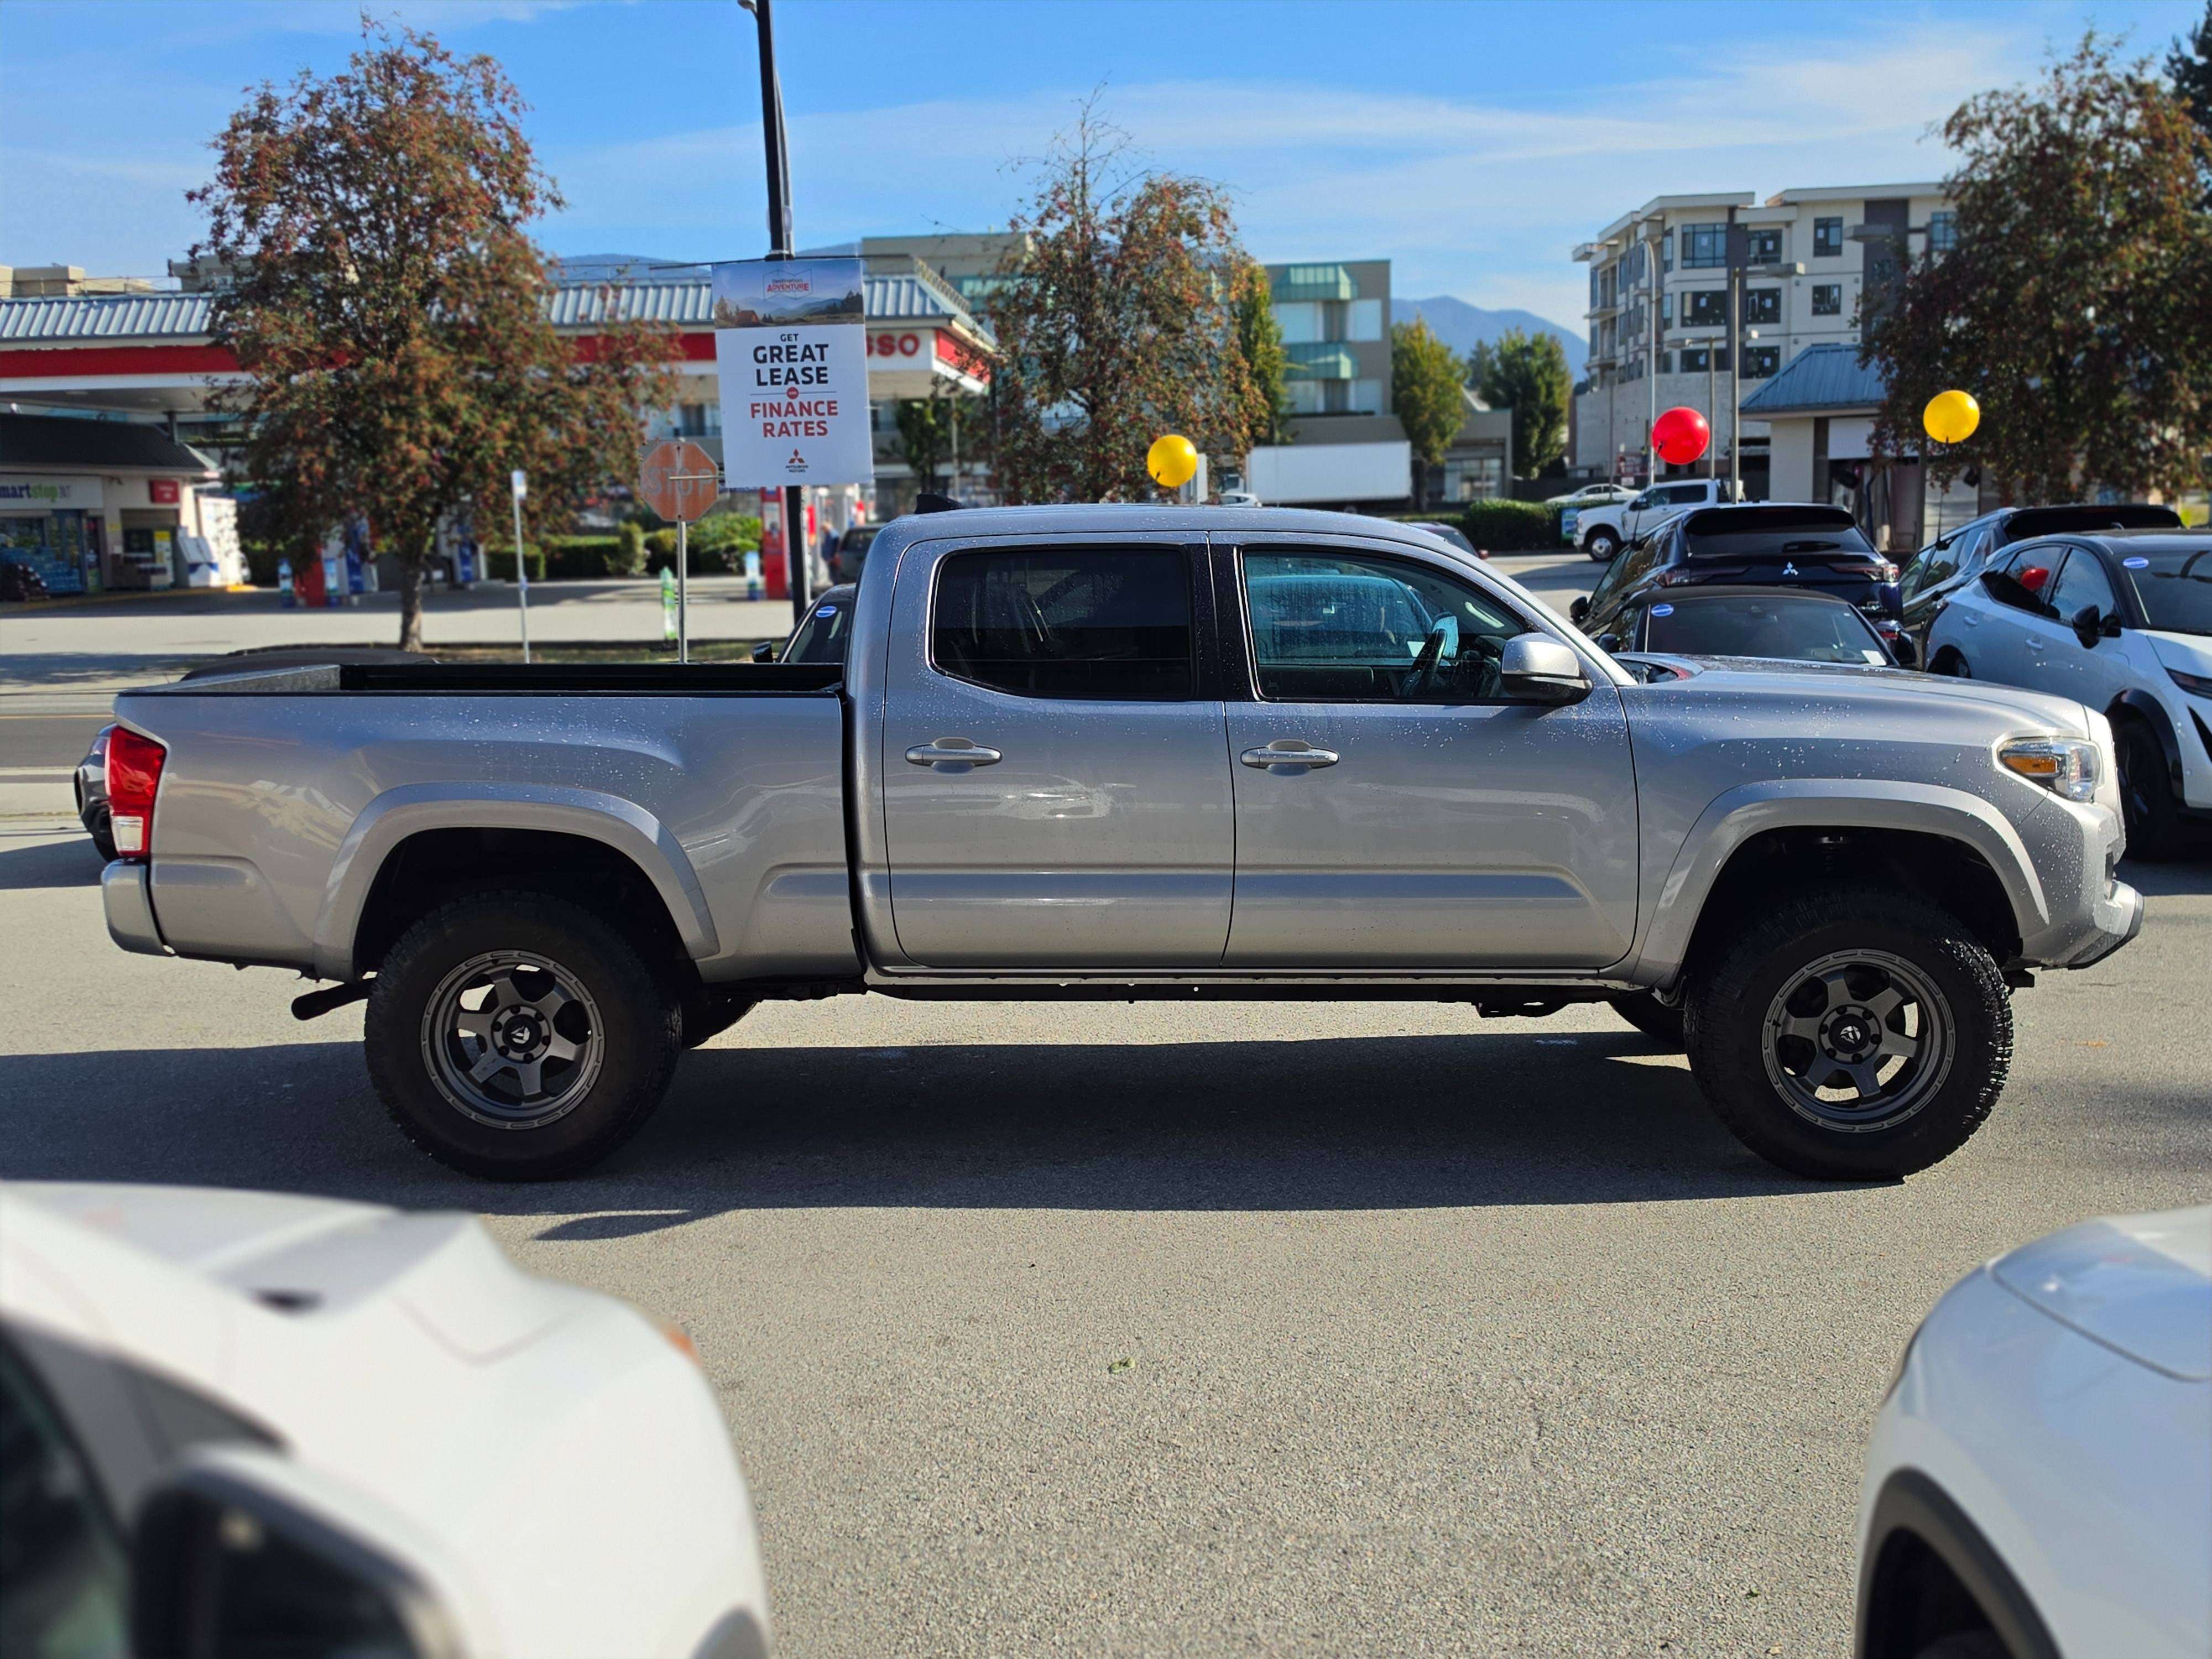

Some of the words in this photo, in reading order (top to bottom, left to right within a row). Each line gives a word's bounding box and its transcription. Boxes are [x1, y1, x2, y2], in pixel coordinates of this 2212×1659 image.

[767, 283, 809, 292] ADVENTURE
[780, 333, 799, 342] GET
[753, 344, 828, 364] GREAT
[756, 367, 828, 386] LEASE
[750, 400, 838, 418] FINANCE
[763, 421, 828, 437] RATES
[645, 467, 713, 496] STOP
